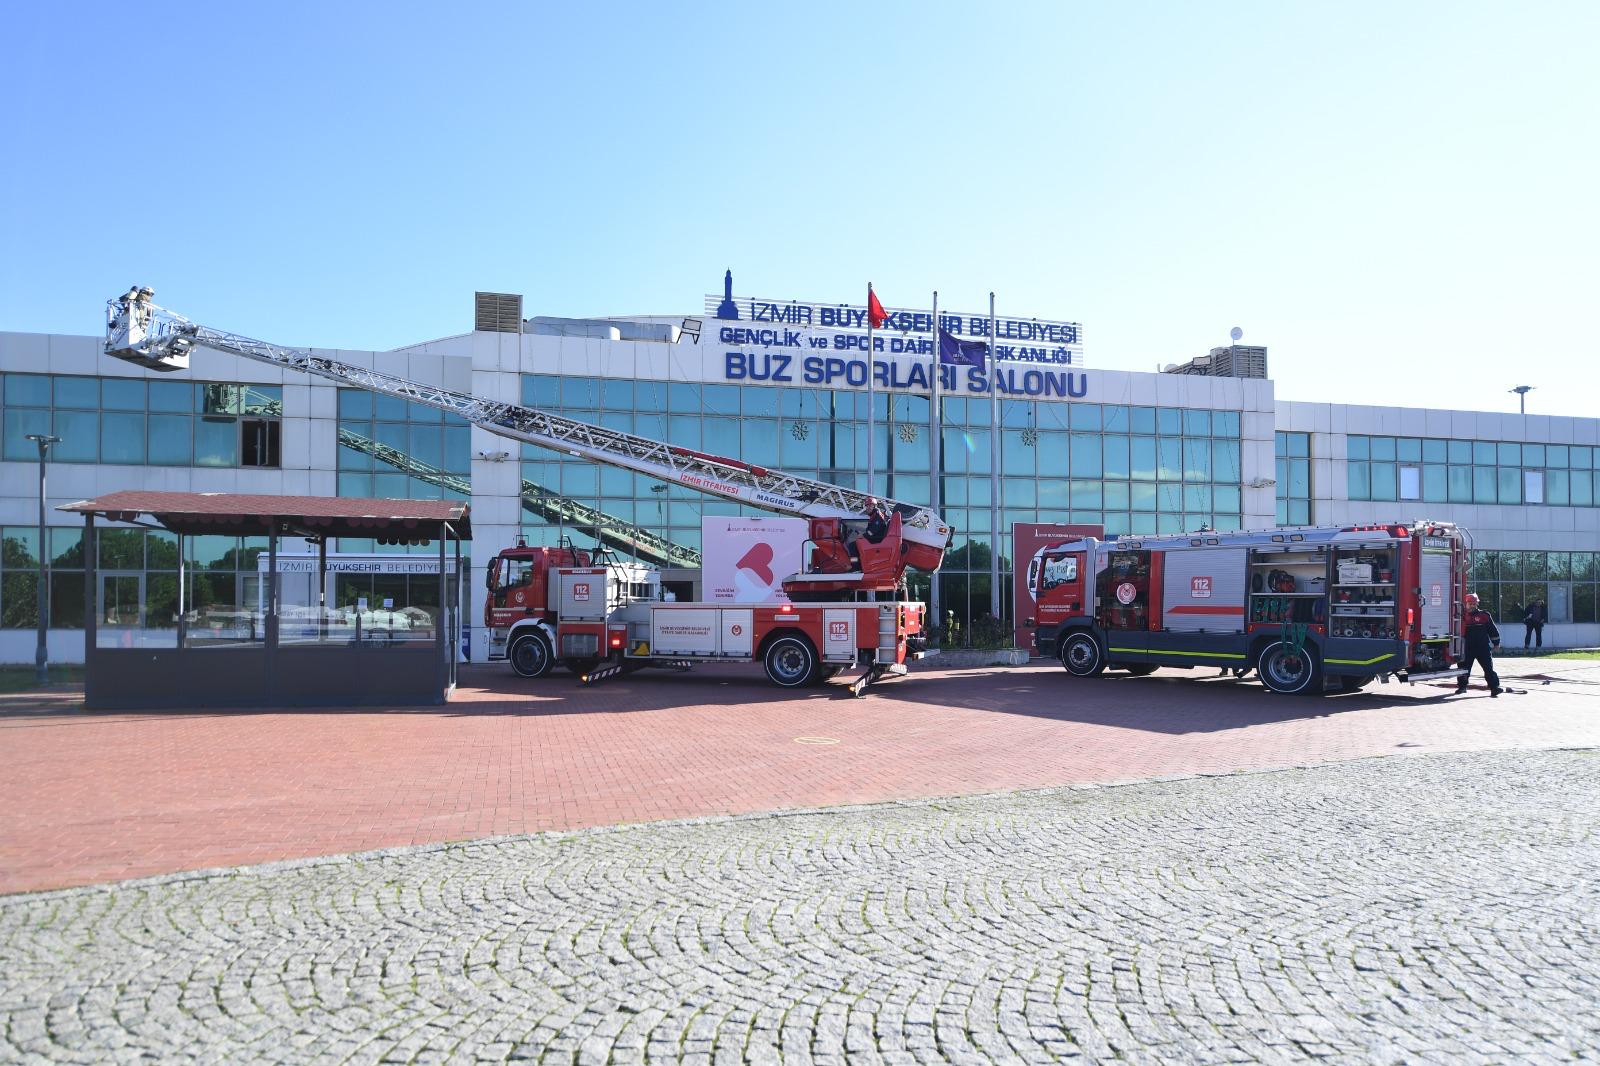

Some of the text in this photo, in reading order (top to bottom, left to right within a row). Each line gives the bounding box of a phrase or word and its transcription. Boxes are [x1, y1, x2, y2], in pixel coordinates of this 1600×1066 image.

[751, 297, 1077, 344] İZMİR BÜYKŞEHİR BELEDİYESİ
[720, 327, 802, 349] GENÇLİK
[808, 336, 828, 349] ve
[834, 334, 885, 353] SPOR
[725, 352, 1088, 398] BUZ SPORLARI SALONU
[756, 494, 796, 508] MAGIRUS
[325, 562, 381, 572] ÜYÜKŞEHİR
[575, 585, 588, 595] 112
[1194, 578, 1209, 590] 112
[832, 623, 846, 634] 112
